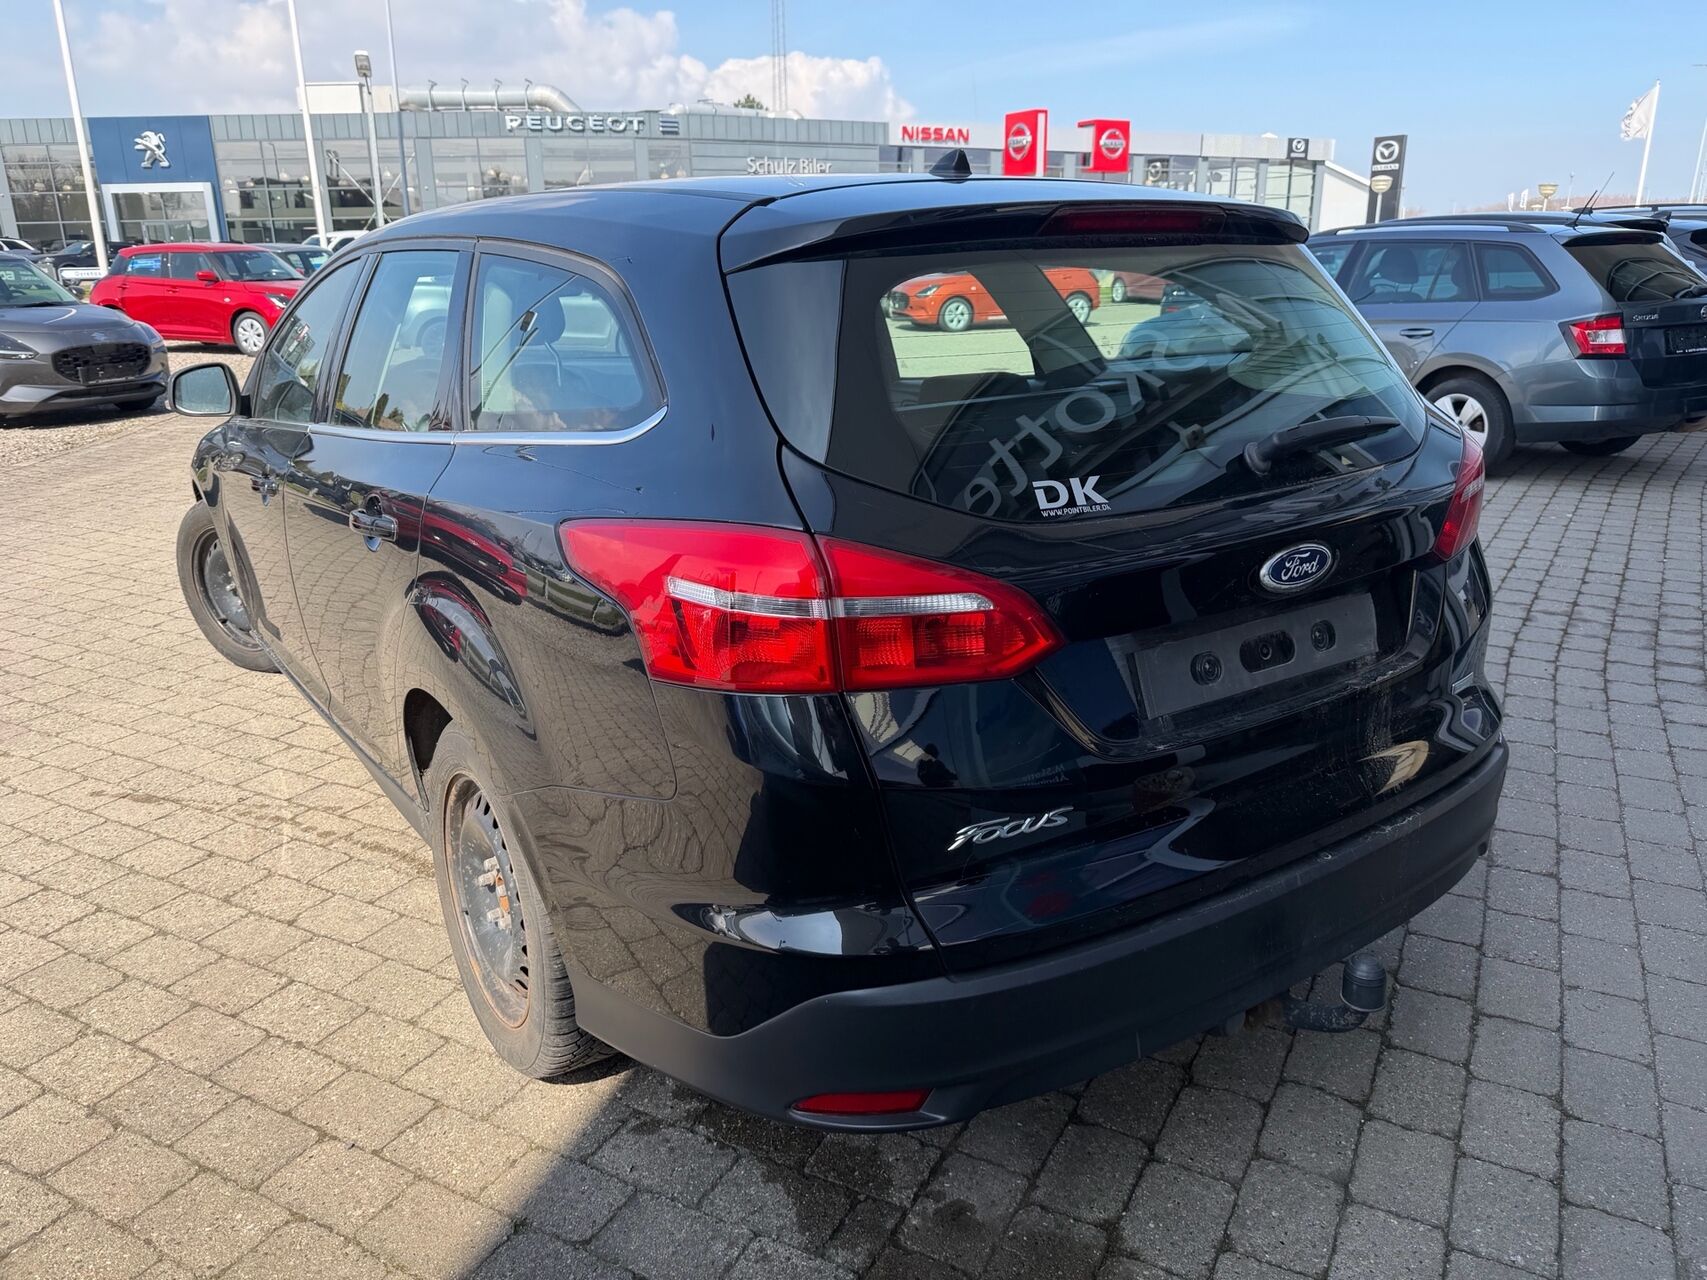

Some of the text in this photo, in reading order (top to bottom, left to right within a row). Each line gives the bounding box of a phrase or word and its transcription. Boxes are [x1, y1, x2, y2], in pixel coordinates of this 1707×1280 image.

[505, 115, 644, 133] PEUGEOT
[901, 125, 970, 144] NISSAN
[1032, 475, 1109, 510] DK
[1040, 503, 1111, 518] WWW.POINTBILER.DK
[1280, 551, 1320, 581] Ford
